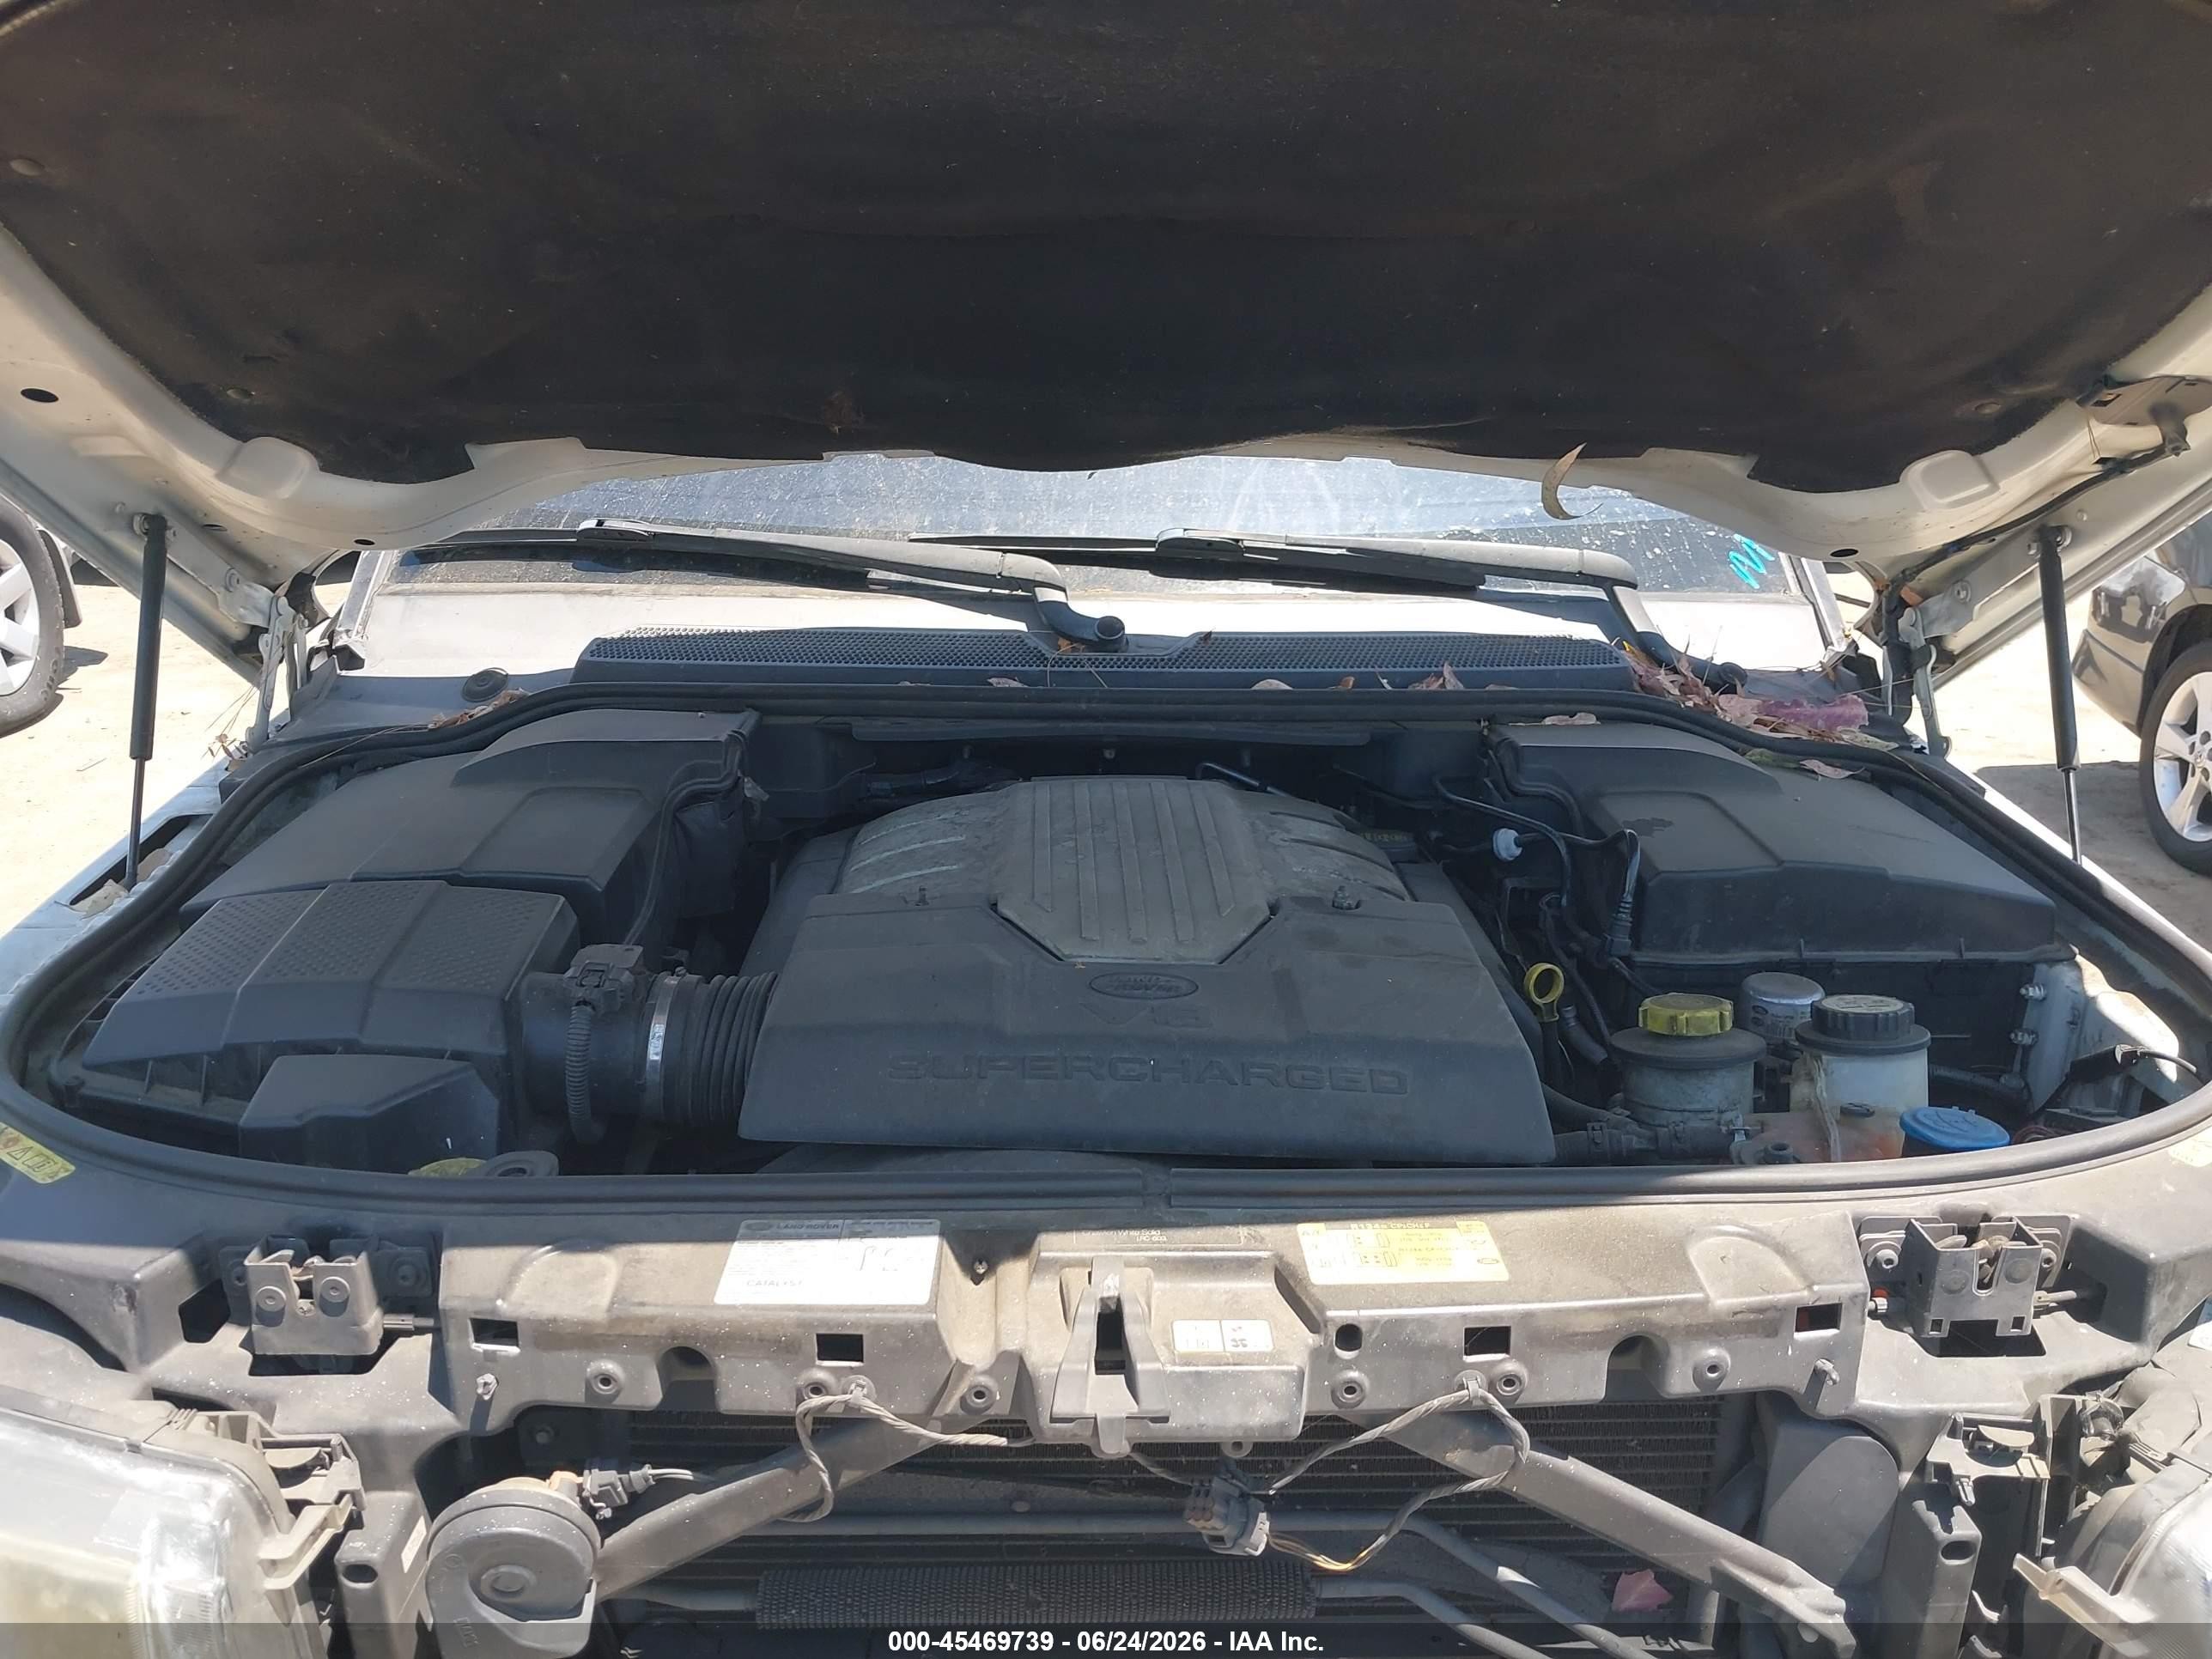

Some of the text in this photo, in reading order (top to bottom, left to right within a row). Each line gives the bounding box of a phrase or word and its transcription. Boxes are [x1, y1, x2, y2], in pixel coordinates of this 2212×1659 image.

[888, 1054, 1408, 1096] SUPERCHARGED
[805, 1222, 840, 1231] ROVER
[745, 1279, 805, 1287] CATALYST
